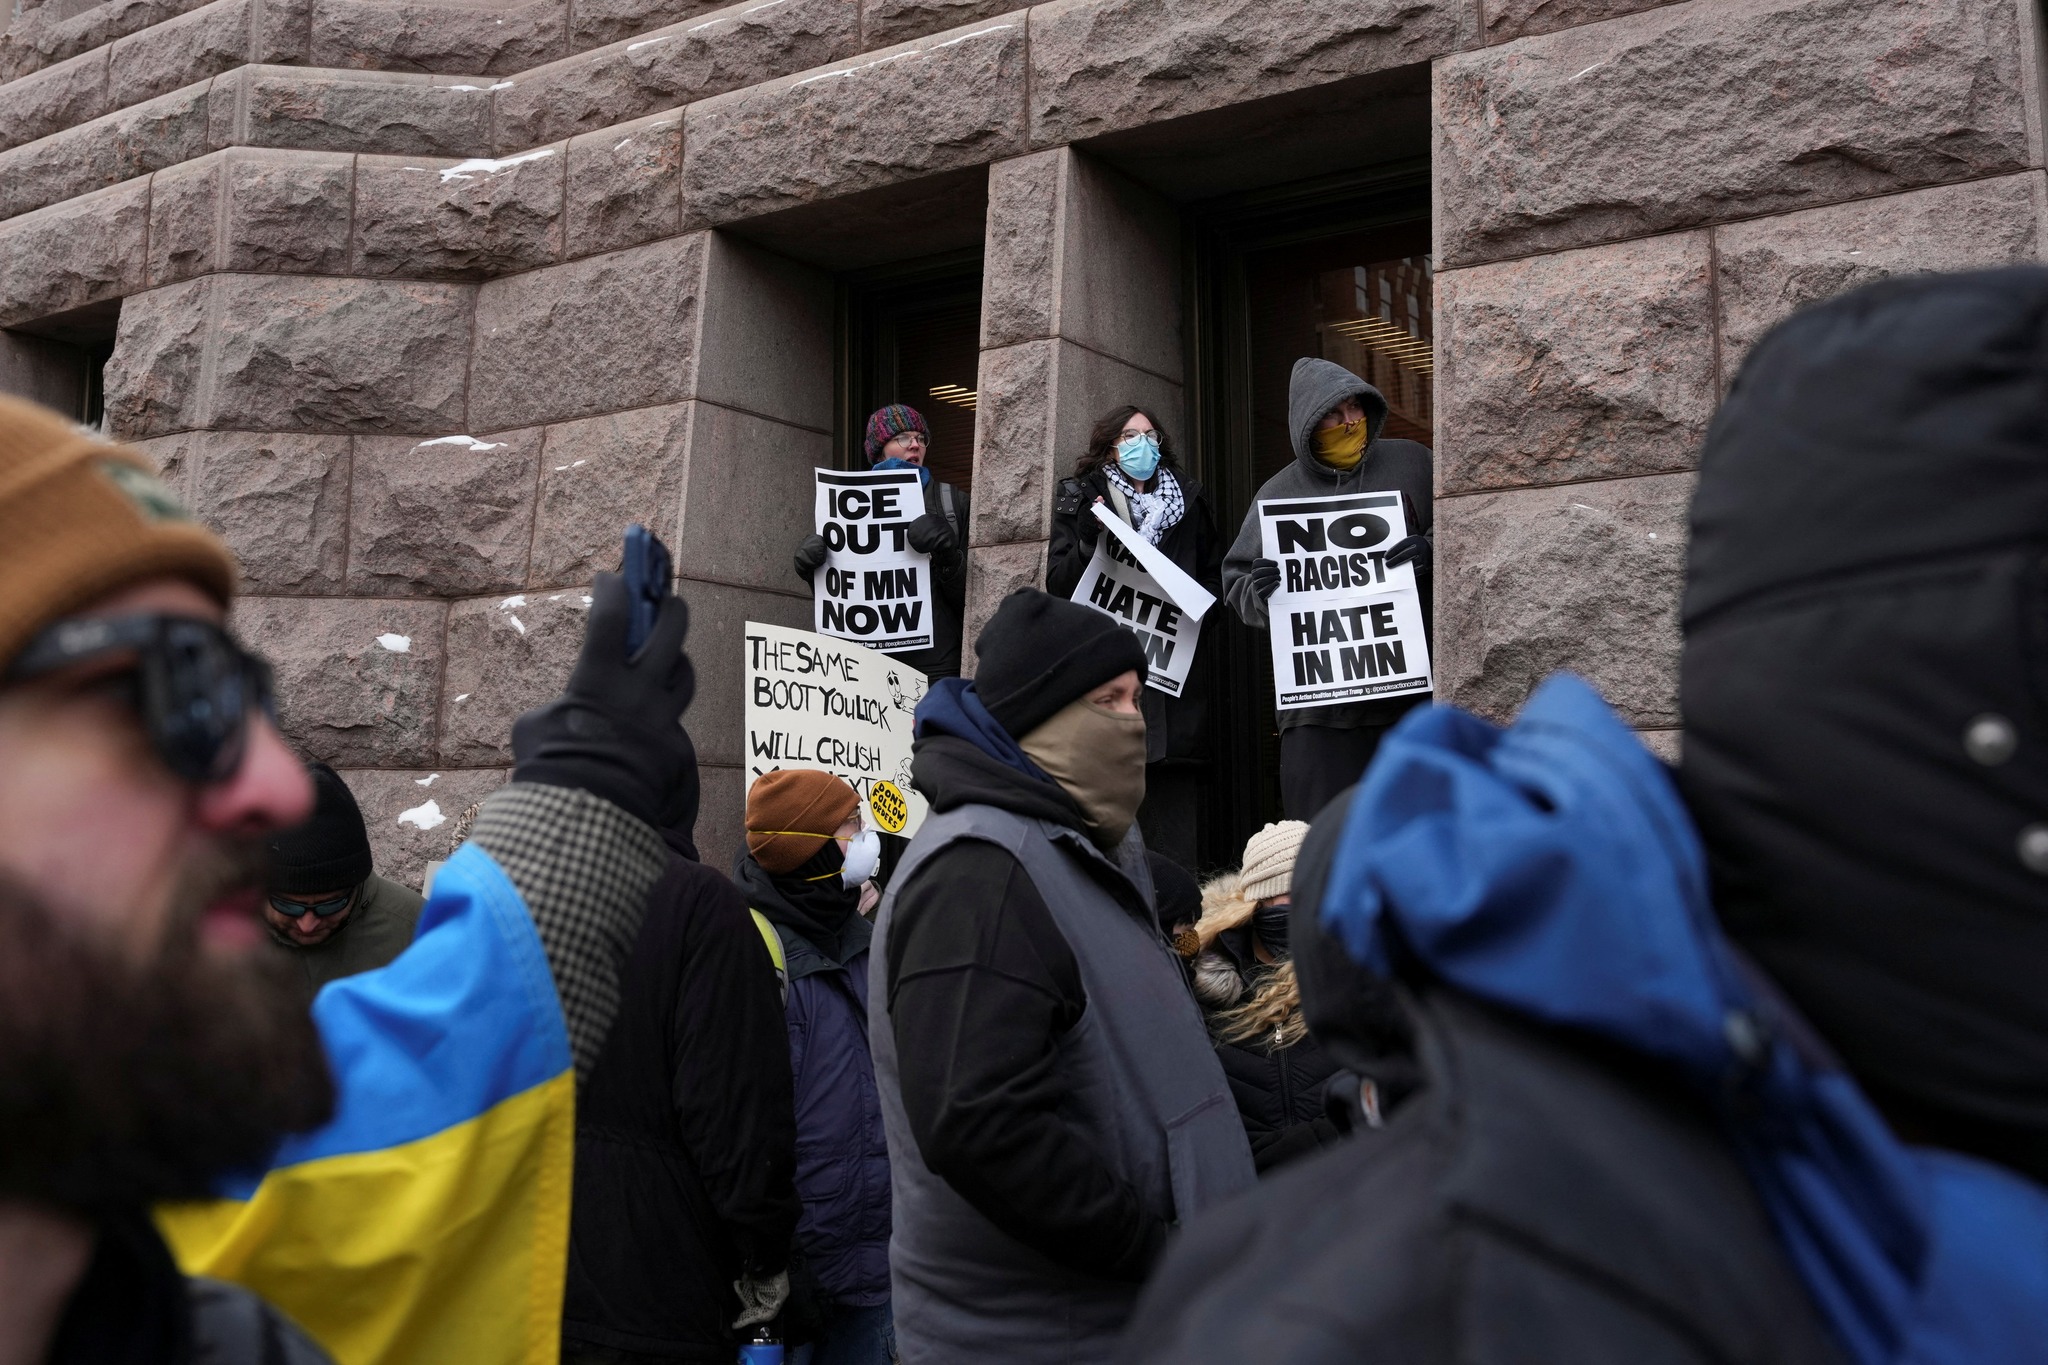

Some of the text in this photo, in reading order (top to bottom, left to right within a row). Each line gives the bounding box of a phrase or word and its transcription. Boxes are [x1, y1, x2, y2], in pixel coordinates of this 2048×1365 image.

[828, 488, 902, 520] ICE
[822, 521, 909, 554] OUT
[1276, 513, 1390, 554] NO
[826, 567, 918, 601] OF MN
[1285, 550, 1387, 593] RACIST
[822, 599, 923, 635] NOW
[1089, 572, 1182, 636] HATE
[1290, 602, 1398, 647] HATE
[746, 636, 859, 682] THE SAME
[1292, 640, 1407, 686] IN MN
[754, 677, 817, 711] BOOT
[856, 695, 892, 732] LICK
[1299, 693, 1312, 701] Action
[1312, 691, 1332, 700] Coalition
[1332, 689, 1349, 698] Against
[1349, 688, 1363, 696] Trump
[751, 730, 881, 772] WILL CRUSH
[872, 788, 905, 822] FOLLOW
[873, 801, 898, 828] ORDERS
